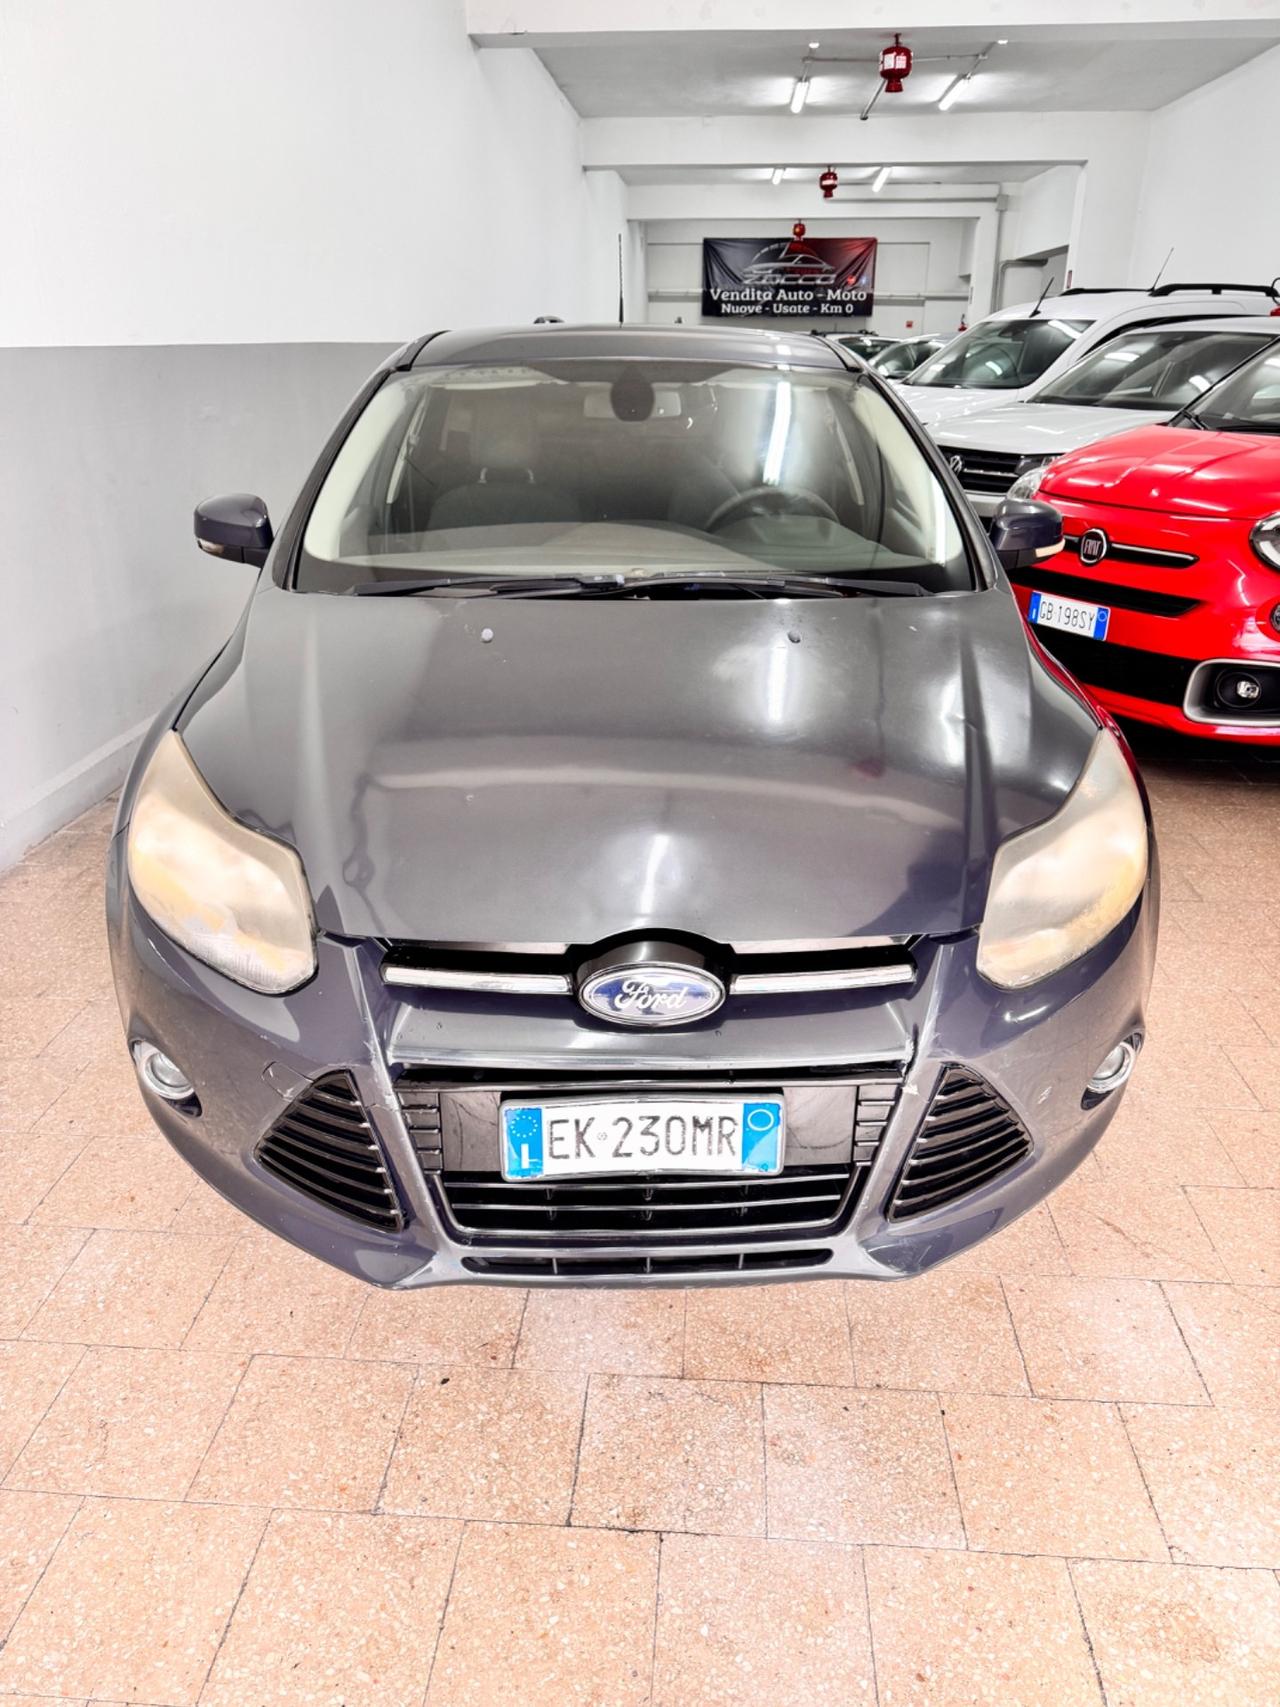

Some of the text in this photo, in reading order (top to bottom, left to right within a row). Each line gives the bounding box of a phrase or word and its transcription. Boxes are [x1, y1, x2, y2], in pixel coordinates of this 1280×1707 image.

[710, 289, 773, 301] Vendita
[777, 289, 814, 301] Auto
[827, 289, 867, 301] Moto
[721, 303, 762, 314] Nuove
[773, 303, 810, 314] Usate
[820, 303, 843, 314] Km
[845, 303, 853, 314] 0
[1084, 539, 1101, 555] FIAT
[614, 979, 688, 1009] Ford
[548, 1115, 738, 1159] EK 230MR
